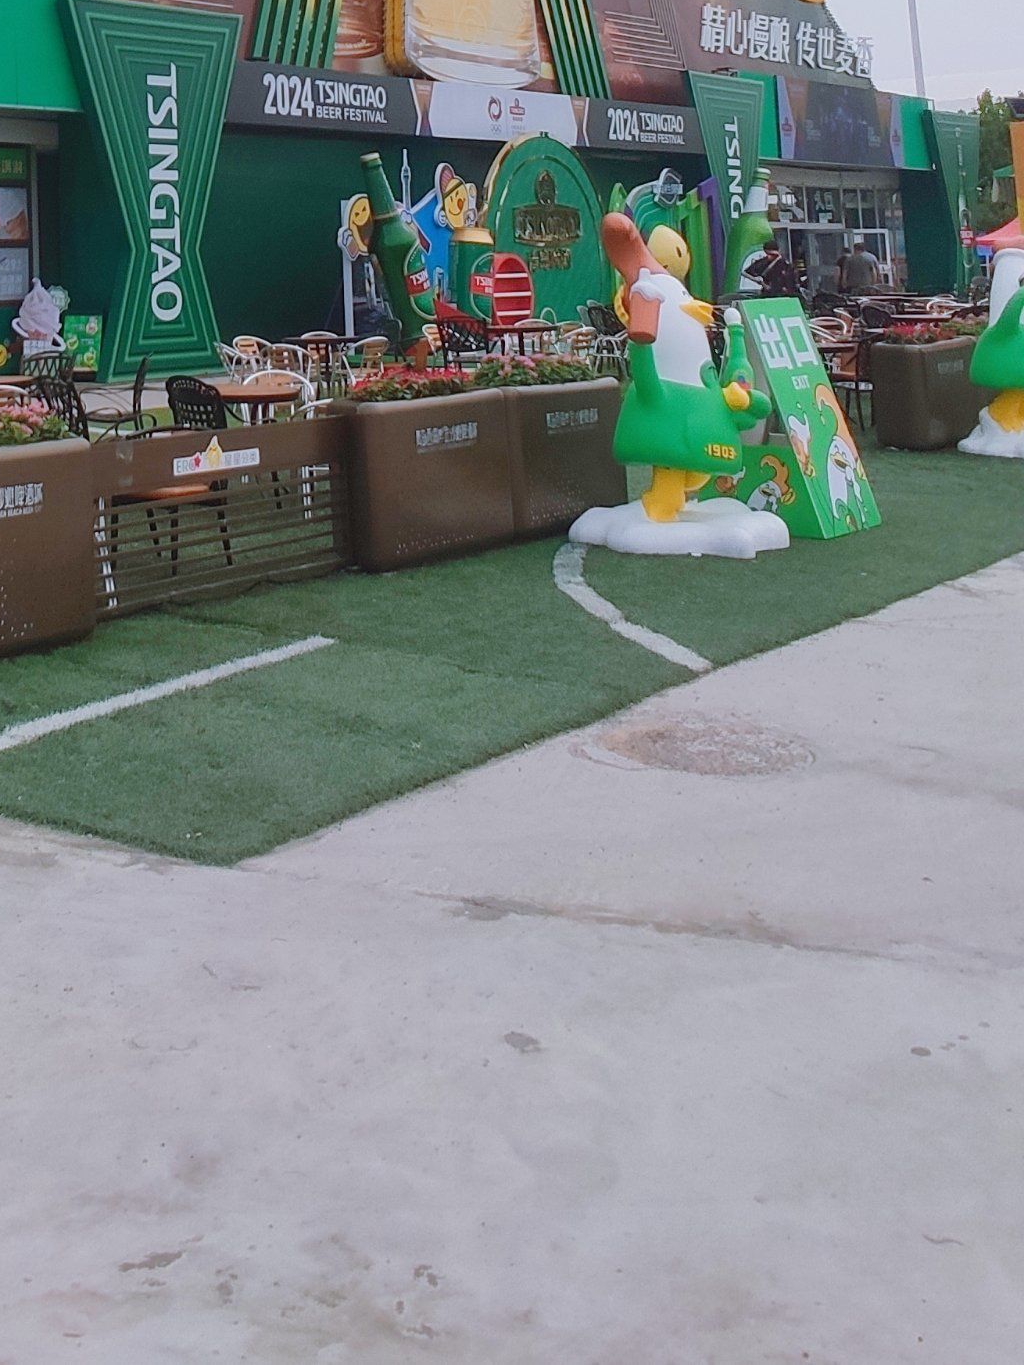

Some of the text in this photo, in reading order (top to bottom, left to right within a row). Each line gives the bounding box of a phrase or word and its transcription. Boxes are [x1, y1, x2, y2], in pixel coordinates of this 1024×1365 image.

[699, 2, 791, 64] 精心慢酿
[262, 73, 387, 118] 2024 TSINGTAO
[316, 105, 388, 124] BEER FESTIVAL
[607, 107, 684, 142] 2024 TSINGTAO
[639, 132, 685, 145] BEER FESTIVAL
[146, 61, 183, 321] TSINGTAO
[753, 313, 819, 370] 出口
[791, 374, 810, 390] EXIT
